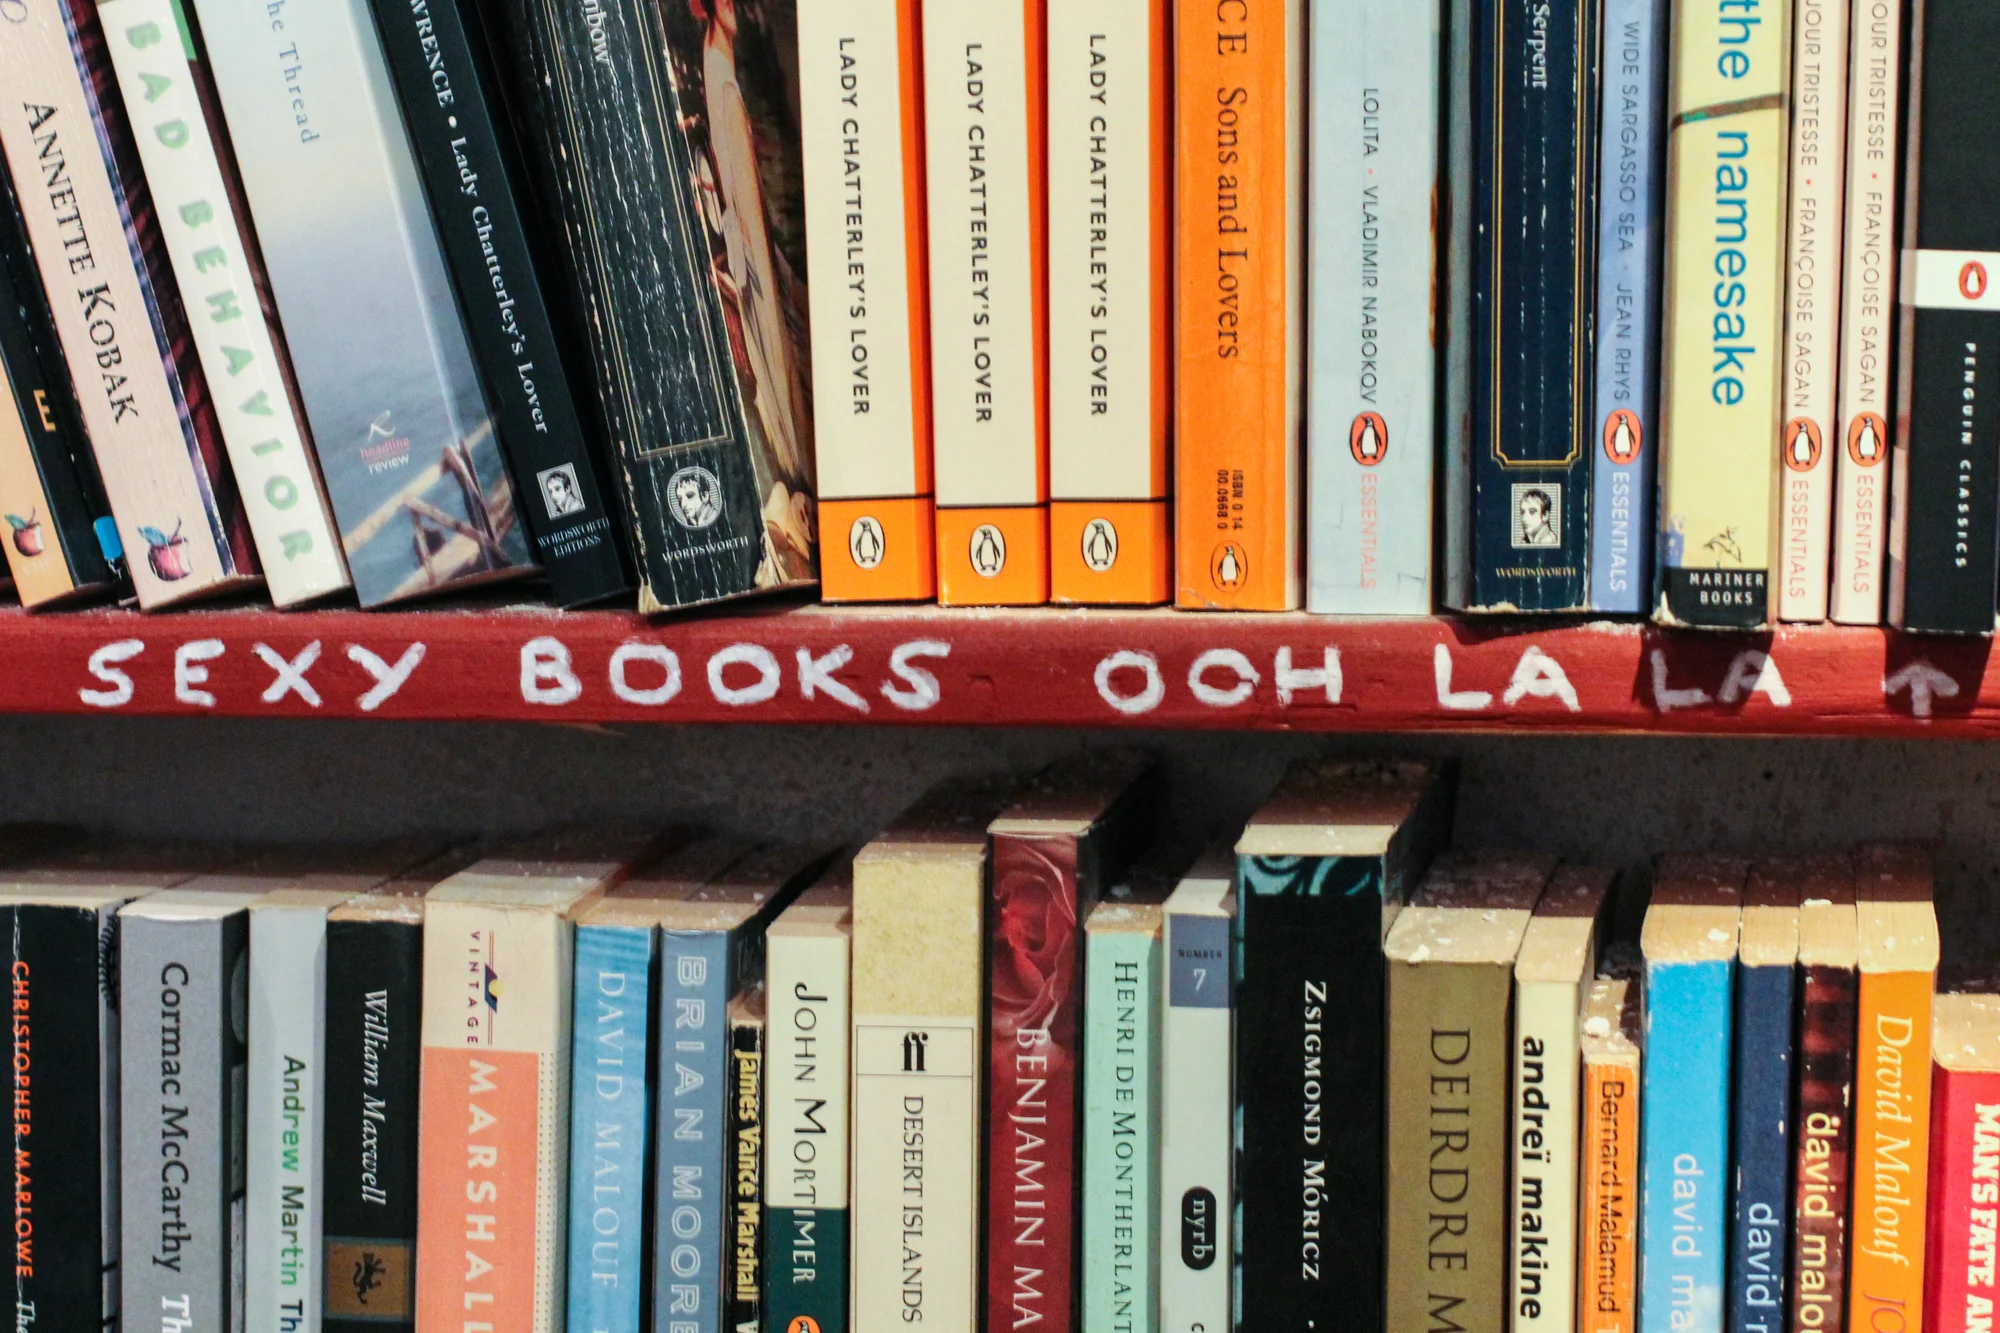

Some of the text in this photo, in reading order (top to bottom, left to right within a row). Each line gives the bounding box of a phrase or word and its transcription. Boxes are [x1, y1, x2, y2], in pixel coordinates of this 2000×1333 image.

[279, 42, 321, 145] Thread
[1526, 3, 1550, 90] Serpent
[1800, 62, 1820, 166] TRISTESSE
[1867, 56, 1887, 161] TRISTESSE
[838, 36, 871, 416] LADY CHATTERLEY'S LOVER
[965, 42, 992, 423] LADY CHATTERLEY'S LOVER
[1088, 33, 1108, 417] LADY CHATTERLEY'S LOVER
[1216, 0, 1249, 360] CE Sons and Lovers
[1613, 20, 1640, 401] WIDE SARGASSO SEA JEAN RHYS
[1711, 0, 1761, 406] the namesake
[22, 100, 140, 425] ANNETTE KOBAK
[124, 20, 314, 562] BAD BEHAVIOR
[451, 136, 478, 198] Lady
[472, 205, 526, 356] Chatterley's
[517, 360, 548, 435] Lover
[1359, 87, 1380, 404] LOLITA VLADIMIR NABOKOV
[1793, 197, 1817, 323] FRANÇOISE
[1859, 191, 1883, 317] FRANÇOISE
[1793, 331, 1813, 409] SAGAN
[1858, 326, 1878, 404] SAGAN
[368, 453, 409, 475] review
[1232, 469, 1243, 498] ISBN
[1954, 341, 1977, 569] PENGUIN CLASSICS
[537, 516, 610, 548] WORDSWORTH
[554, 535, 602, 558] EDITIONS
[661, 535, 749, 562] WORDSWORTH
[1360, 472, 1378, 590] ESSENTIALS
[1495, 566, 1577, 578] WORDSWORTH
[1608, 471, 1630, 592] ESSENTIALS
[1689, 571, 1764, 587] MARINER
[1788, 478, 1809, 599] ESSENTIALS
[1852, 473, 1874, 595] ESSENTIALS
[1700, 590, 1753, 605] BOOKS
[79, 638, 426, 711] SEXY
[520, 636, 952, 713] BOOKS
[1433, 642, 1582, 712] LA
[1650, 648, 1792, 713] LA
[467, 930, 481, 1045] VINTAGE
[1114, 960, 1139, 1055] HENRI
[1178, 948, 1223, 959] NUMBER
[1193, 968, 1206, 992] 7
[11, 960, 32, 1137] CHRISTOPHER
[160, 961, 189, 1096] Cormac
[674, 955, 707, 1141] BRIAN
[734, 1048, 763, 1122] James
[1115, 1065, 1135, 1103] DE
[280, 1054, 306, 1173] Andrew
[361, 987, 390, 1206] William Maxwell
[591, 971, 626, 1289] DAVID MALOUF
[792, 982, 829, 1284] JOHN MORTIMER
[1007, 1027, 1048, 1247] BENJAMIN
[1302, 980, 1329, 1281] ZSIGMOND MÓRICZ
[1427, 1027, 1471, 1271] DEIRDRE
[1599, 1080, 1625, 1188] Bernard
[1862, 1012, 1914, 1268] David Malouf
[14, 1150, 33, 1278] MARLOWE
[152, 1104, 192, 1274] McCarthy
[736, 1124, 762, 1196] Vance
[901, 1095, 924, 1324] DESERT ISLANDS
[1519, 1036, 1551, 1320] andreï makine
[1672, 1153, 1705, 1257] david
[1803, 1112, 1839, 1218] david
[280, 1186, 305, 1287] Martin
[735, 1202, 761, 1302] Marshall
[1184, 1198, 1214, 1260] nyrb
[1597, 1191, 1623, 1315] Malamud
[1744, 1202, 1780, 1308] david
[1967, 1208, 1998, 1288] FATE
